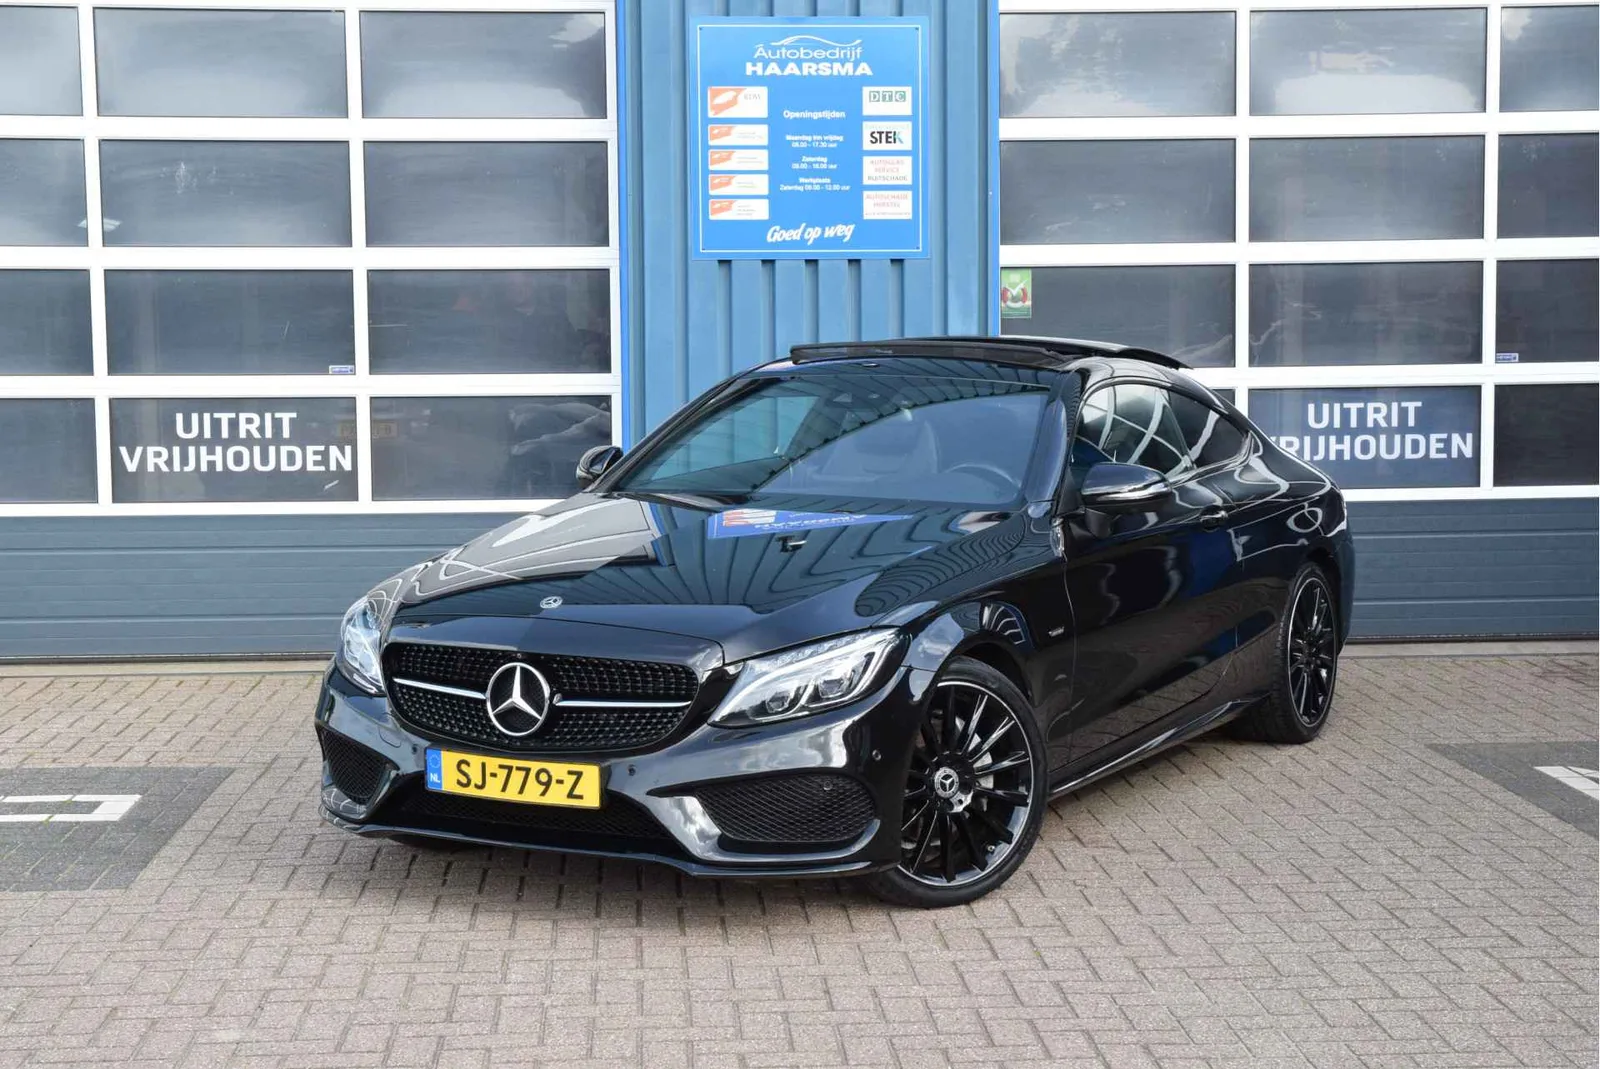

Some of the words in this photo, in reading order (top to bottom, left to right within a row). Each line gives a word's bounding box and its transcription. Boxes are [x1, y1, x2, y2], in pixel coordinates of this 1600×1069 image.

[745, 61, 874, 76] HAARSMA
[869, 90, 906, 103] DTC
[783, 109, 847, 120] Openingstijden
[869, 130, 905, 145] STEK
[766, 223, 806, 243] Goed
[803, 226, 822, 246] op
[824, 223, 856, 243] weg
[175, 412, 297, 439] UITRIT
[1307, 401, 1422, 429] UITRIT
[1269, 432, 1474, 462] RIJHOUDEN
[119, 445, 352, 473] VRIJHOUDEN
[430, 773, 440, 784] NL
[455, 758, 585, 801] SJ-779-Z
